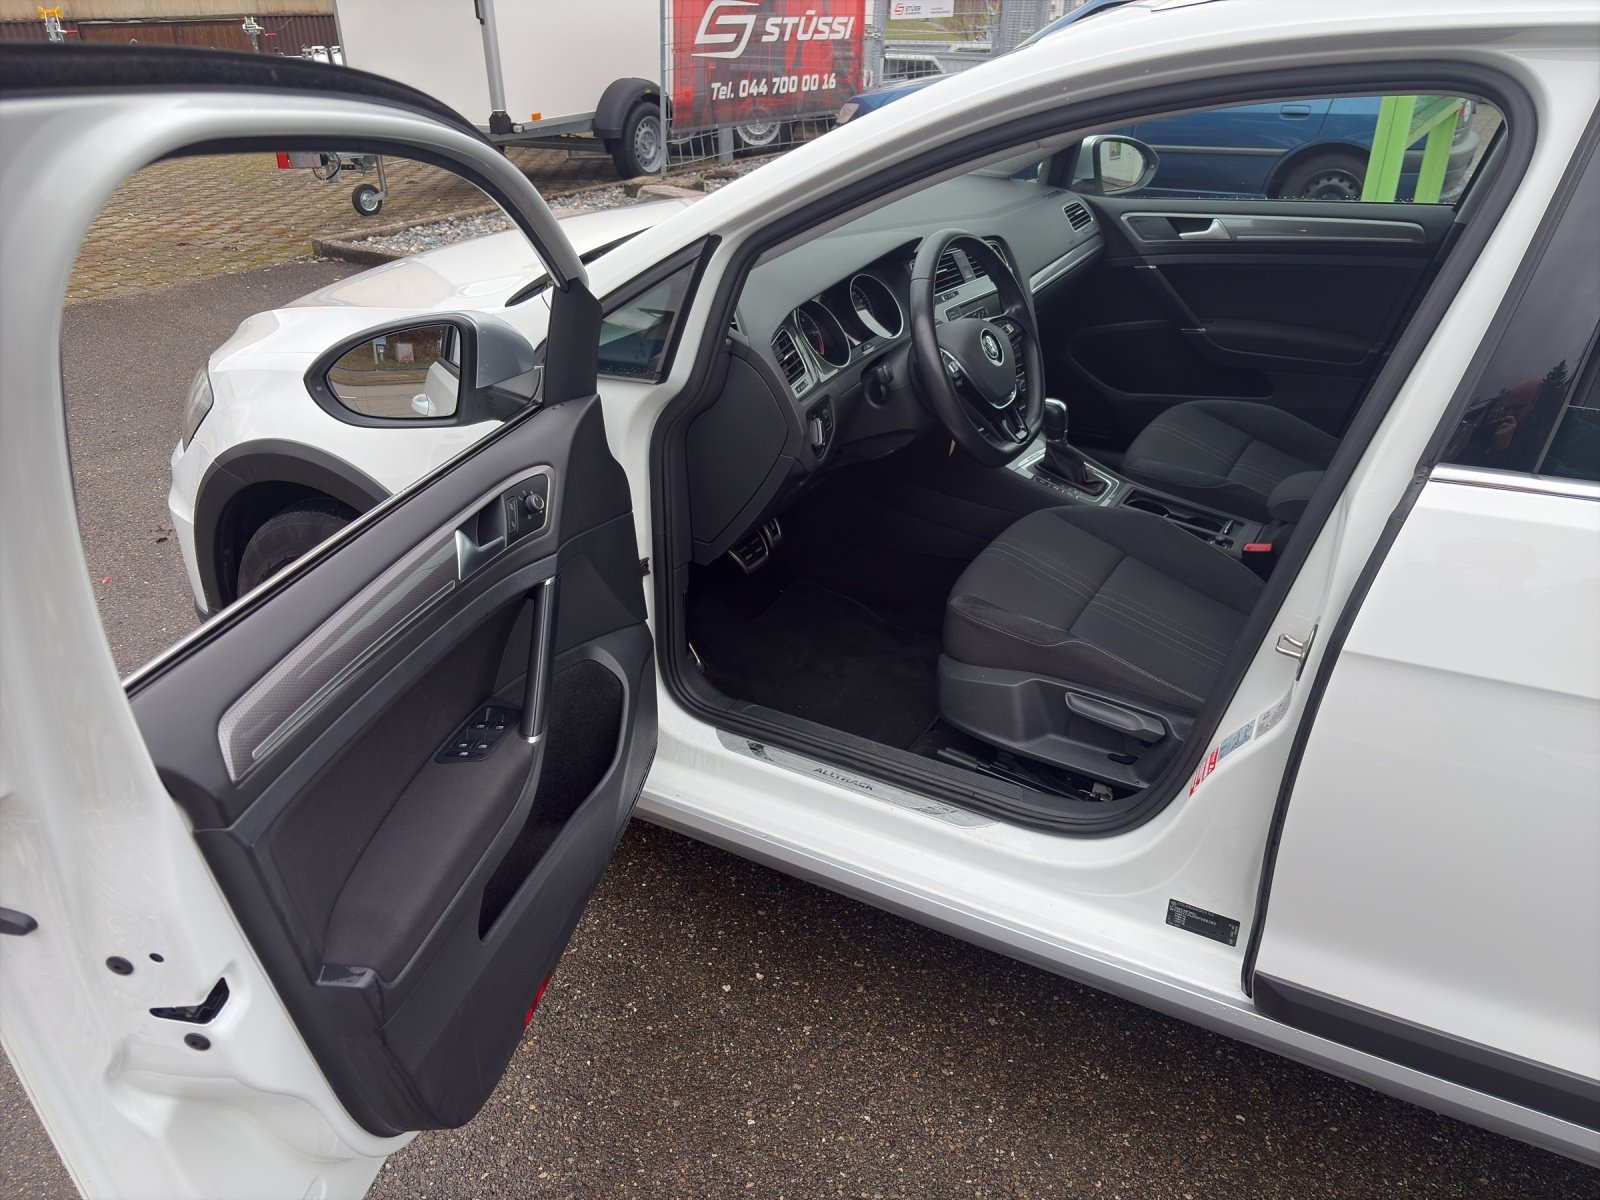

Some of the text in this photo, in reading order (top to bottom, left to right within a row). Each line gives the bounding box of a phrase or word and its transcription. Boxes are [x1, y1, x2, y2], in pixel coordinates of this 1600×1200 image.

[711, 73, 836, 100] Tel. 044 700 00 16
[813, 767, 875, 790] ALLTRACK
